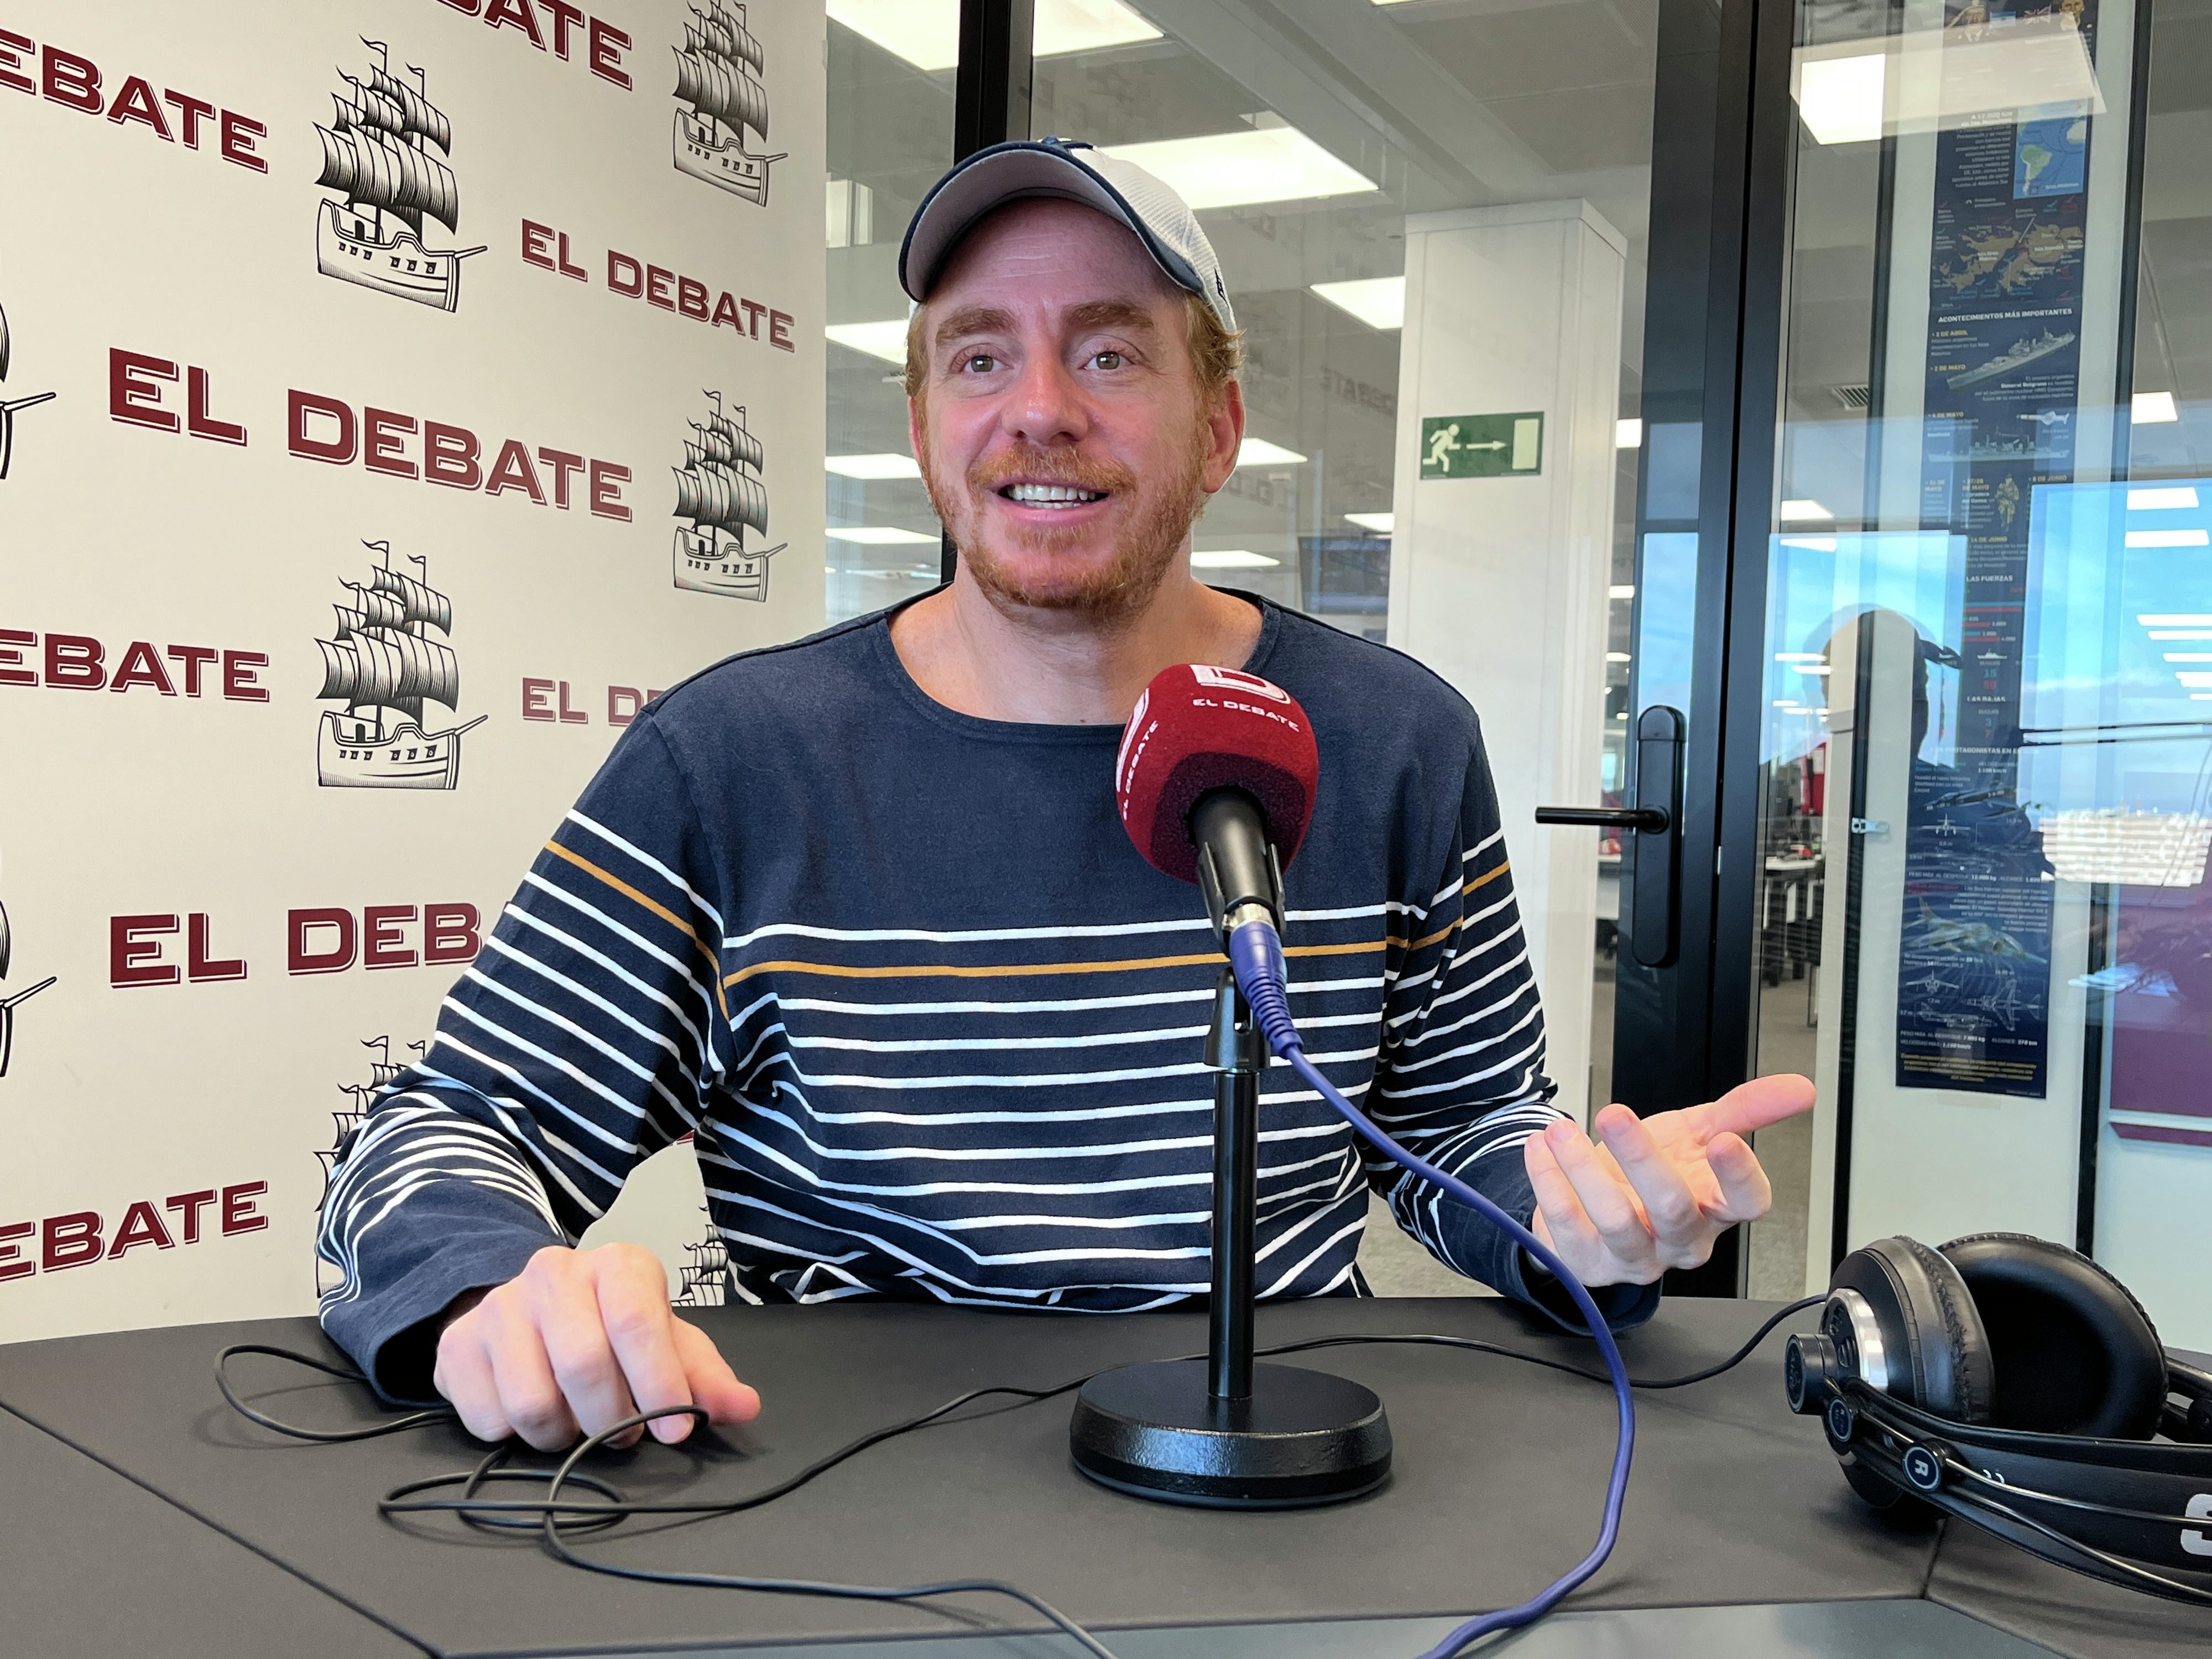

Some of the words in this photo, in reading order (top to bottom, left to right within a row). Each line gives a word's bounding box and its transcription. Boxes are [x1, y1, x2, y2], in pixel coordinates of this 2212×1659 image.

[0, 29, 268, 174] EBATE
[521, 218, 587, 282] EL
[608, 249, 795, 353] DEBATE
[1938, 312, 2004, 323] ACONTECIMIENTOS
[2004, 309, 2020, 319] MÁS
[2021, 308, 2073, 317] IMPORTANTES
[110, 347, 247, 447] EL
[288, 388, 633, 523] DEBATE
[0, 629, 270, 702] EBATE
[523, 677, 588, 724] EL
[1192, 698, 1218, 708] EL
[1223, 700, 1300, 732] DEBATE
[111, 912, 247, 989] EL
[288, 901, 512, 977] DEB
[0, 1180, 268, 1282] EBATE
[1914, 1459, 1928, 1477] R
